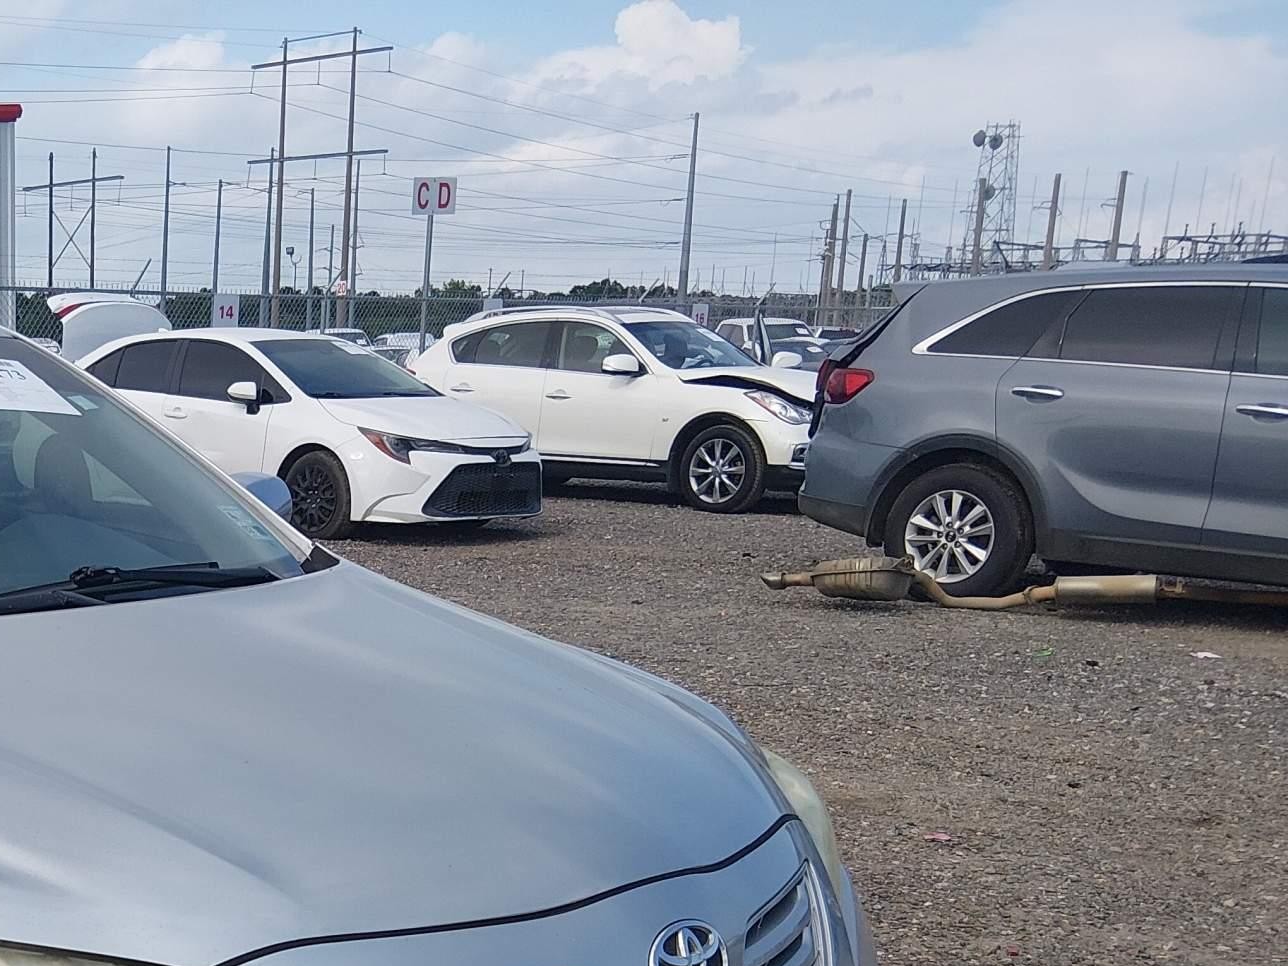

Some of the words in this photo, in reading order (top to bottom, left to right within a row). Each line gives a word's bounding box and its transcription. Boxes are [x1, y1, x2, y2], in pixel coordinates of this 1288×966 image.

[418, 182, 430, 209] C
[438, 182, 451, 209] D
[219, 305, 234, 319] 14
